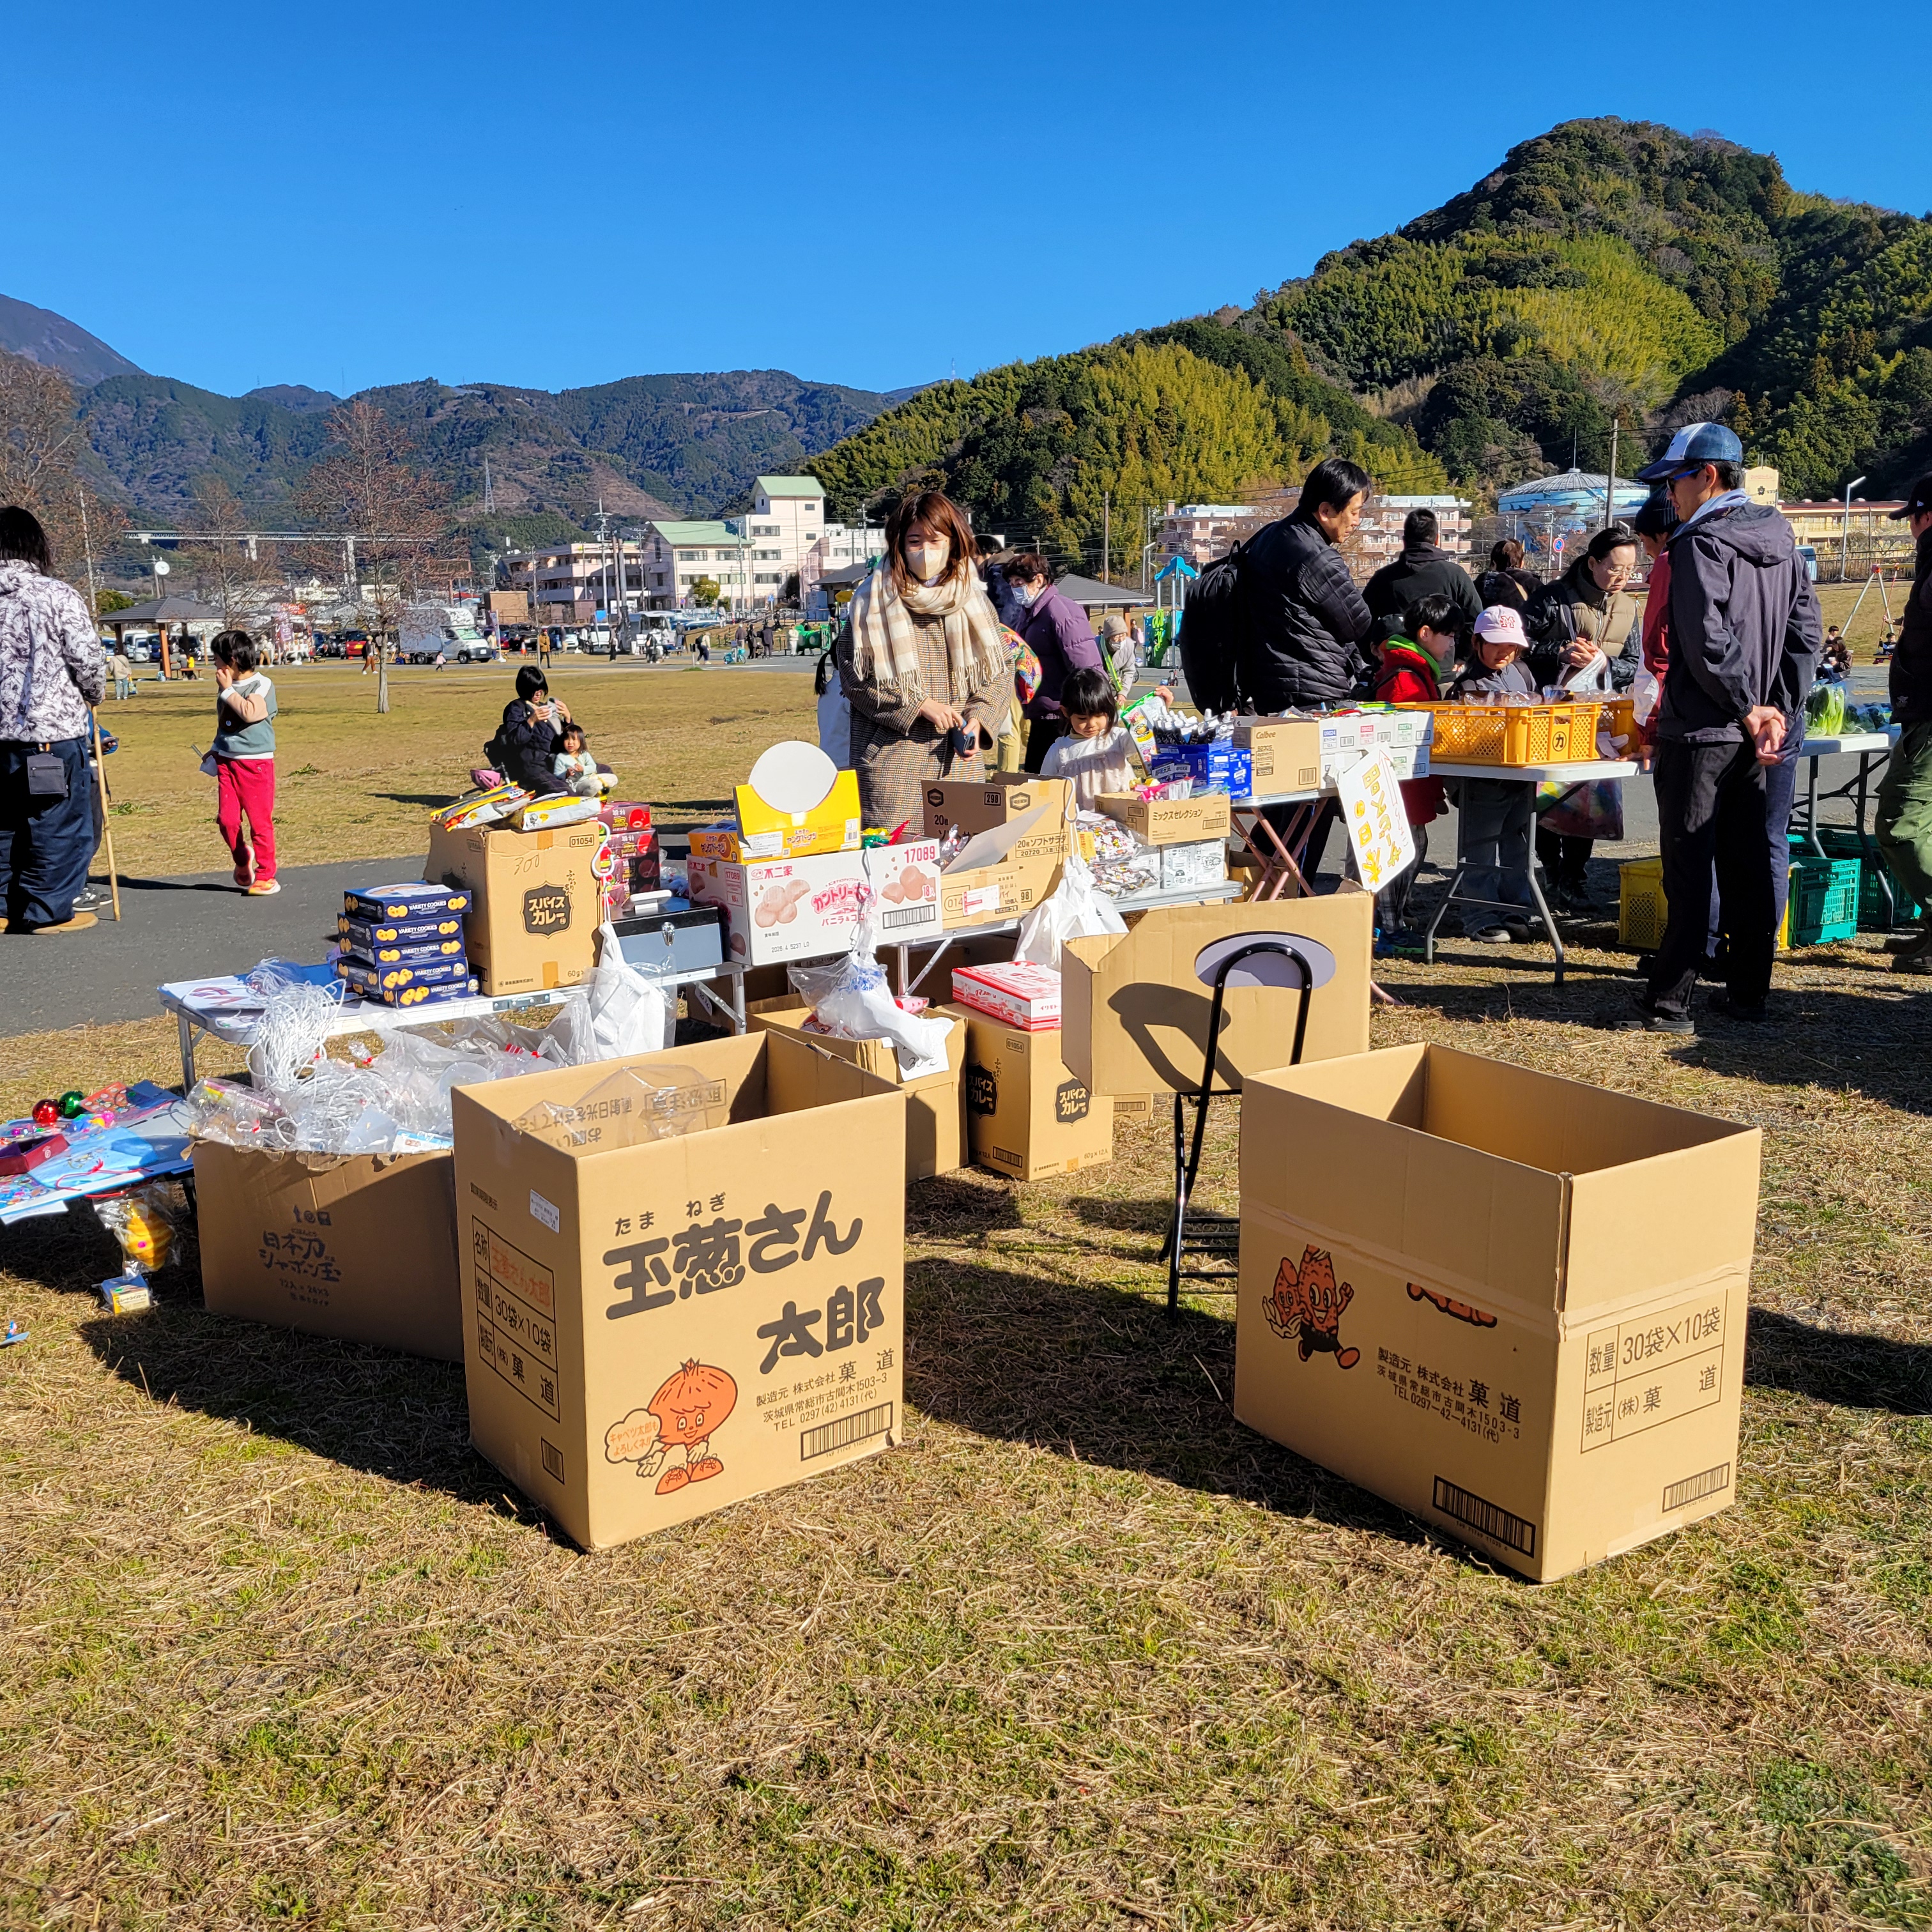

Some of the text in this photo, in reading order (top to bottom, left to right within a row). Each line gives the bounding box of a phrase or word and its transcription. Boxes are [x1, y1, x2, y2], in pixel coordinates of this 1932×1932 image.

[1500, 615, 1515, 628] M
[1255, 731, 1276, 739] Calbee
[1555, 735, 1565, 748] カ
[986, 793, 999, 804] 298
[1152, 808, 1203, 822] ミックスセレクション
[1362, 762, 1402, 868] サービス品
[571, 837, 593, 846] 01054
[903, 845, 936, 863] 17089
[725, 870, 740, 880] 17089
[764, 865, 793, 879] 不二家
[923, 884, 935, 898] 18入
[1020, 891, 1030, 901] 98
[409, 902, 427, 910] VARIETY
[528, 896, 565, 912] スパイス
[531, 912, 566, 926] カレー
[1007, 1040, 1023, 1051] 01054
[969, 1075, 993, 1092] スパイス
[970, 1089, 993, 1104] カレー
[1059, 1087, 1087, 1103] スパイス
[1060, 1101, 1087, 1116] カレー
[615, 1192, 726, 1238] たま ねぎ
[263, 1230, 326, 1260] 日本刀
[602, 1190, 864, 1321] 玉葱さん
[258, 1248, 342, 1282] シャボン玉
[756, 1276, 885, 1375] 太郎
[1622, 1305, 1721, 1366] 30袋×10袋
[1588, 1341, 1616, 1377] 数量
[511, 1351, 526, 1385] 菓
[540, 1374, 556, 1407] 道
[756, 1347, 894, 1407] 製造元 株式会社 菓 道
[1377, 1346, 1522, 1424] 製造元 株式会社 菓 道
[1392, 1383, 1409, 1401] TEL
[1586, 1364, 1717, 1436] 製造元 (株) 菓 道
[610, 1420, 659, 1445] キャベツ太郎も
[773, 1418, 796, 1432] TEL
